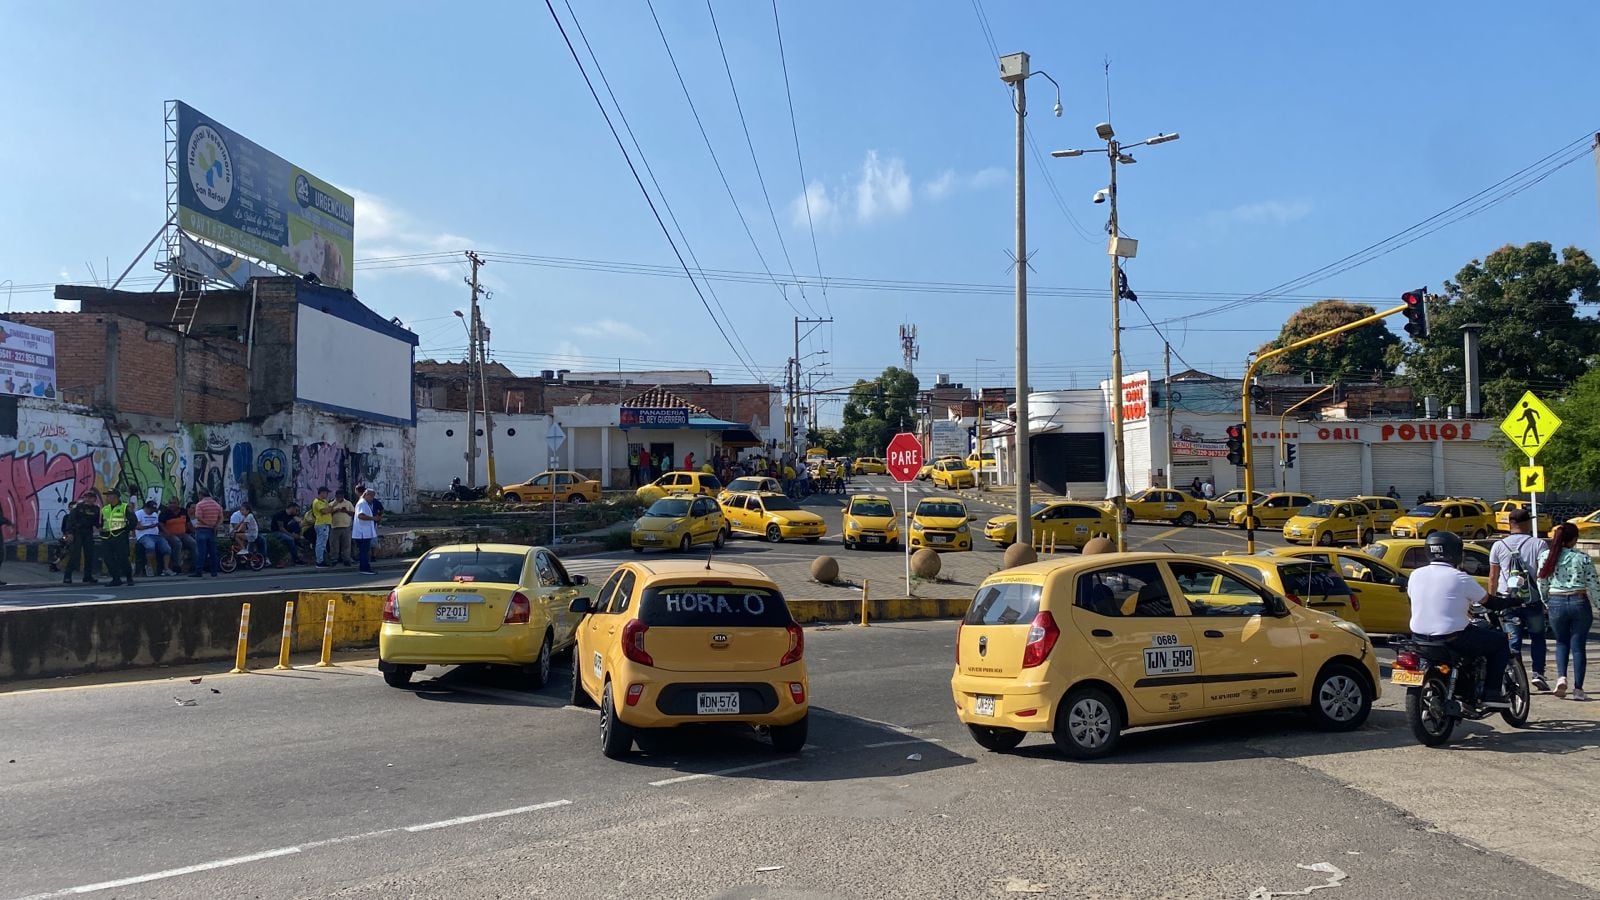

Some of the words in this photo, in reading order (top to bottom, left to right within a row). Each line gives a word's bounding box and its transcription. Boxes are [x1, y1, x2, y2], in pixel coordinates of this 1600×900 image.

[189, 129, 205, 167] Hospital
[194, 182, 207, 196] San
[207, 187, 226, 205] Rafael
[314, 190, 351, 222] URGENCIAS
[639, 416, 646, 424] EL
[647, 416, 657, 424] REY
[658, 416, 686, 424] GUERRERO
[1381, 422, 1472, 442] POLLOS
[891, 450, 918, 466] PARE
[714, 634, 727, 642] KIA
[1156, 635, 1178, 646] 0689
